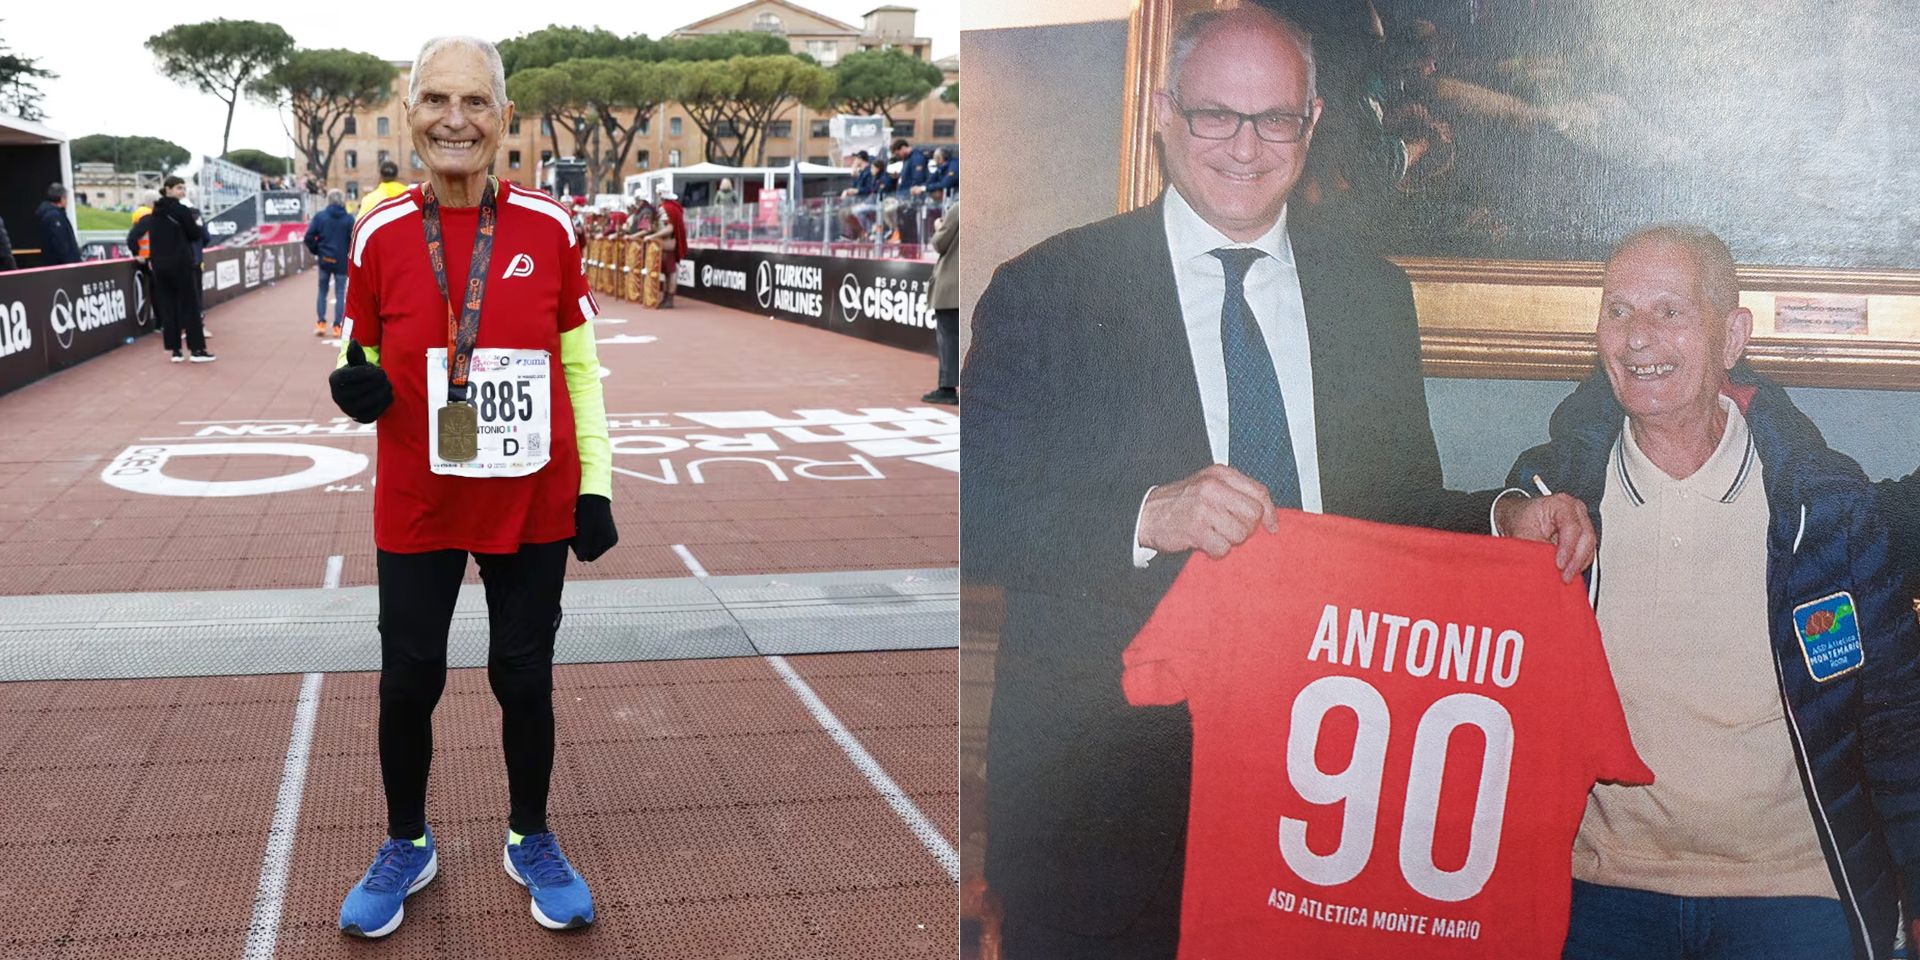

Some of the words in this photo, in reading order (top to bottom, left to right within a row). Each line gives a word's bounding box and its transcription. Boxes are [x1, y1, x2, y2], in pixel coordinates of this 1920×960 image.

[712, 268, 747, 291] HYUNDAI
[774, 263, 822, 291] TURKISH
[75, 285, 127, 332] cisalfa
[774, 289, 823, 318] AIRLINES
[477, 425, 506, 434] TONIO
[503, 438, 519, 456] D
[1307, 604, 1525, 688] ANTONIO
[1278, 675, 1515, 902] 90
[1267, 888, 1296, 912] ASD
[1298, 897, 1368, 927] ATLETICA
[1372, 911, 1428, 935] MONTE
[1431, 917, 1481, 940] MARIO
